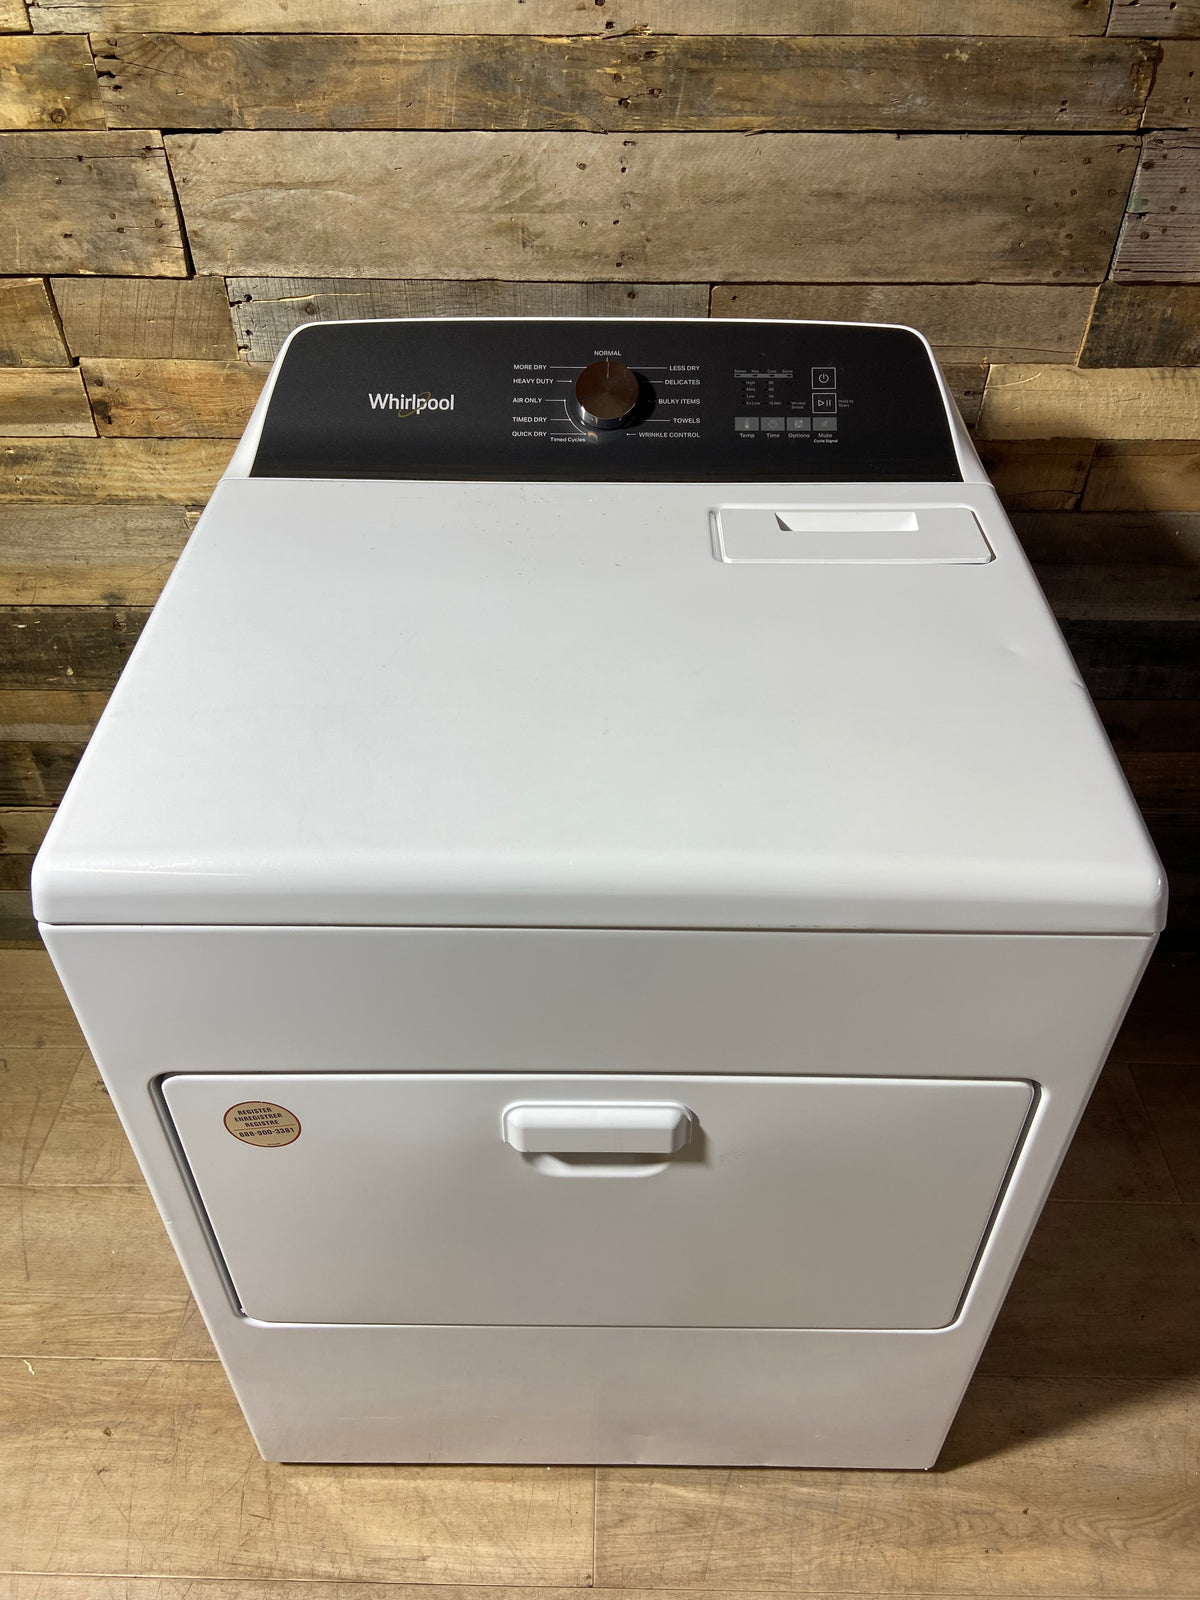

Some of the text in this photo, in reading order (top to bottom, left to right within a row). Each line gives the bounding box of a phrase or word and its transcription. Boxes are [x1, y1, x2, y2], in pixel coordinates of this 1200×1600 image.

[368, 393, 455, 415] Whirlpool
[237, 1107, 273, 1116] REGISTER
[234, 1112, 283, 1123] ENREGISTRER
[244, 1119, 280, 1128] REGISTRE
[238, 1127, 295, 1138] 888-900-3381
